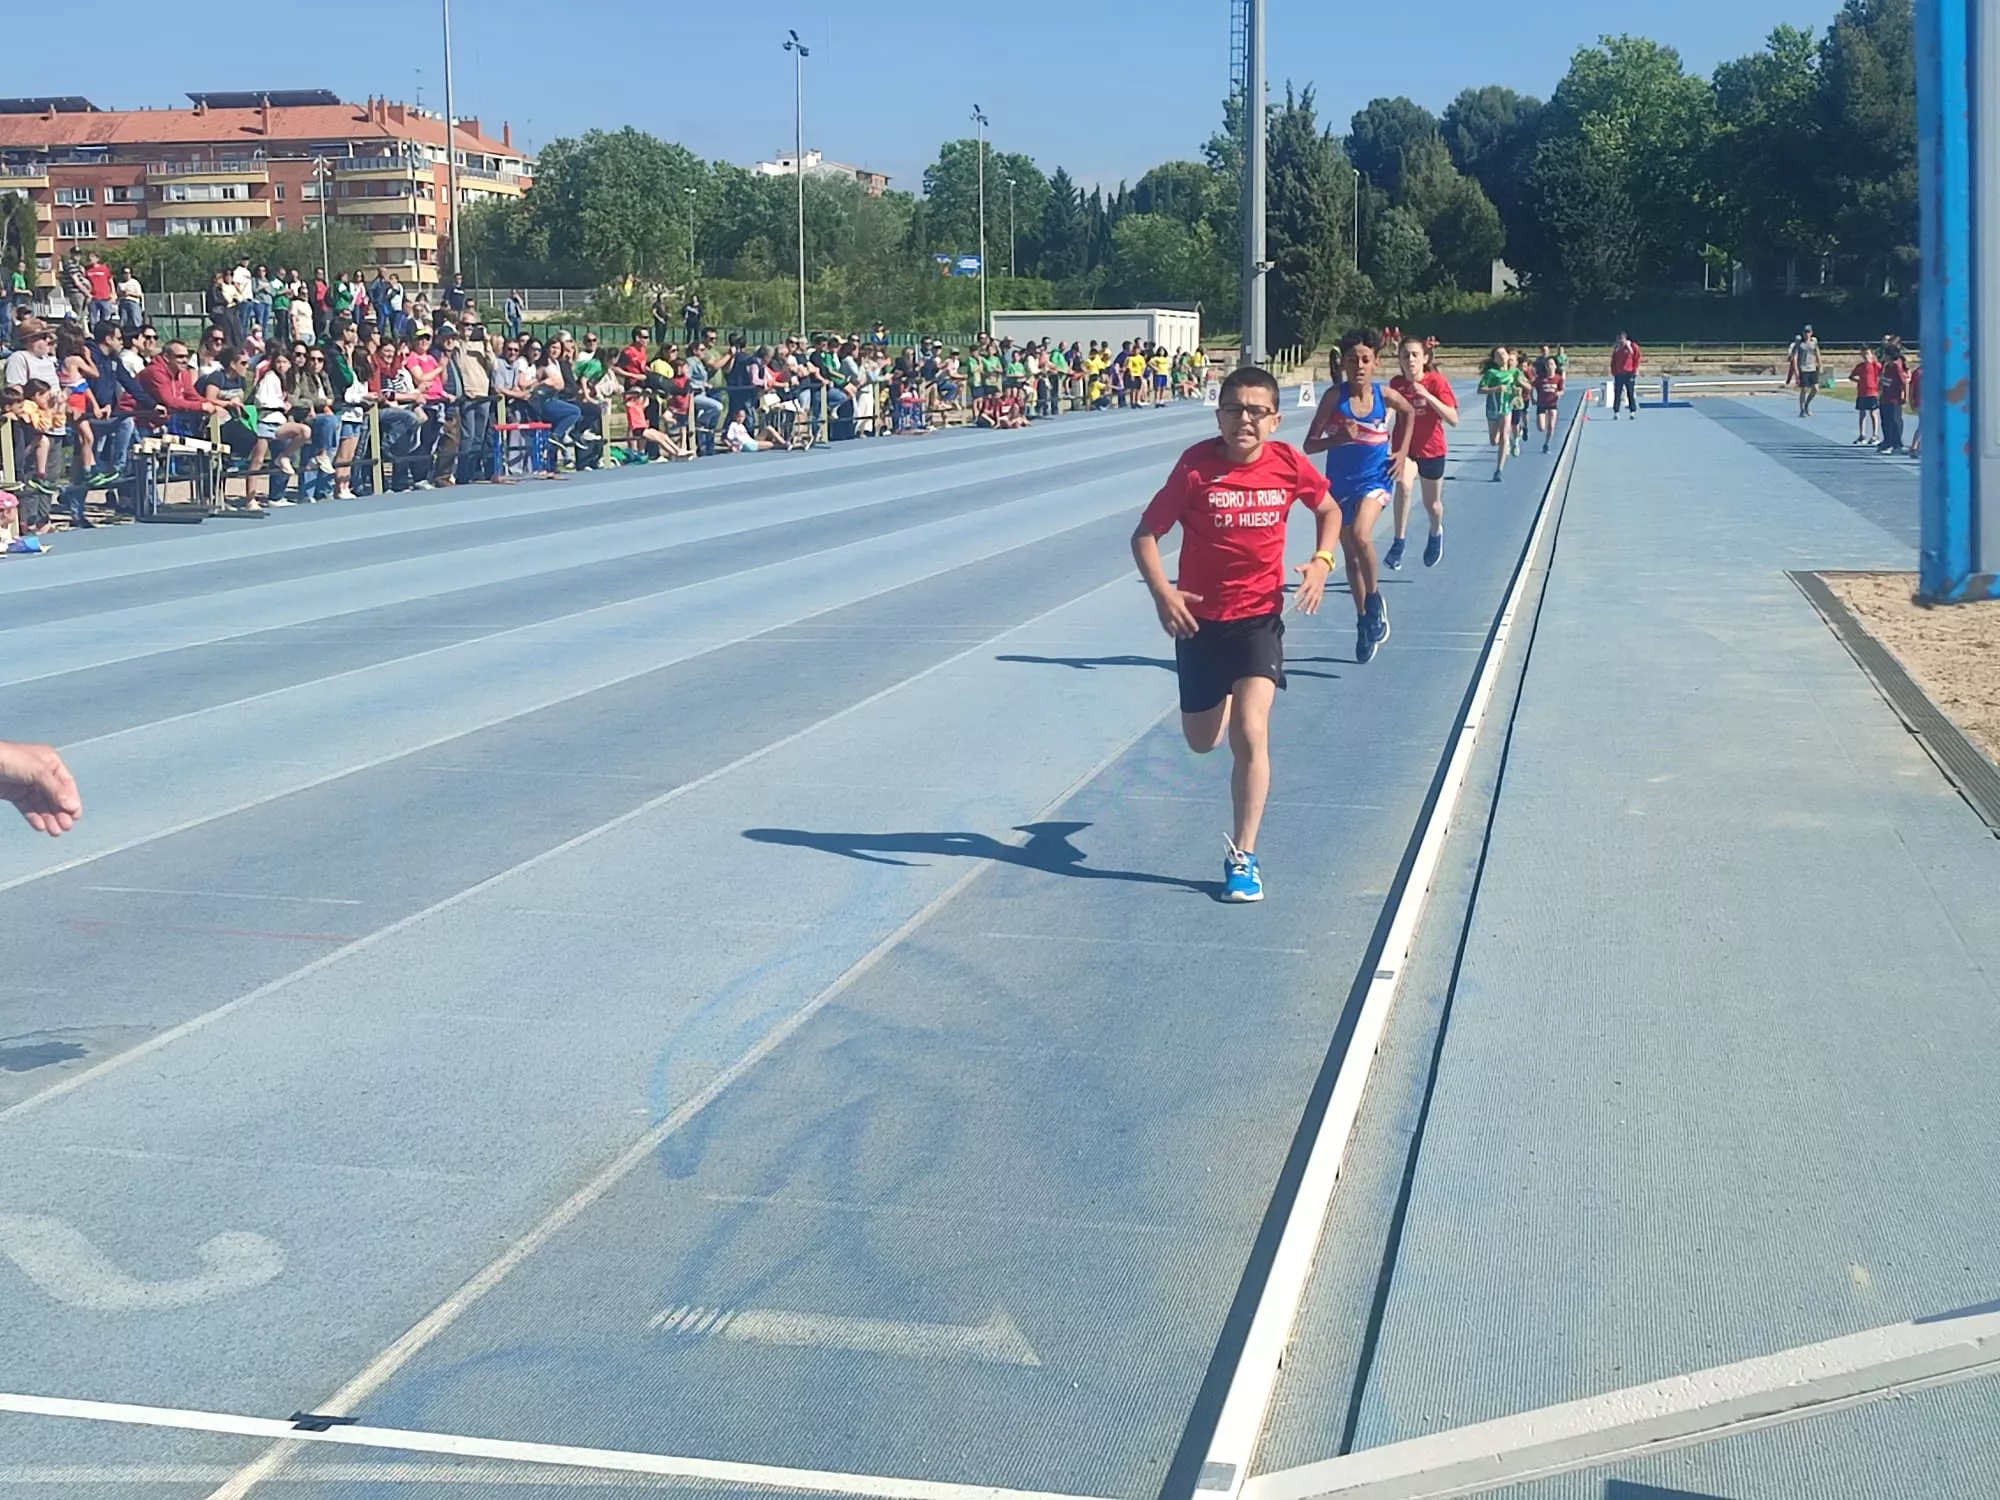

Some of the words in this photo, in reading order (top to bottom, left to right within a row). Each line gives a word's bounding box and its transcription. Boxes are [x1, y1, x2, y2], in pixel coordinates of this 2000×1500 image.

[1208, 389, 1216, 401] 8
[1302, 388, 1311, 401] 6
[1208, 490, 1245, 508] PEDRO
[1246, 490, 1256, 507] J.
[1256, 488, 1287, 506] RUBIO
